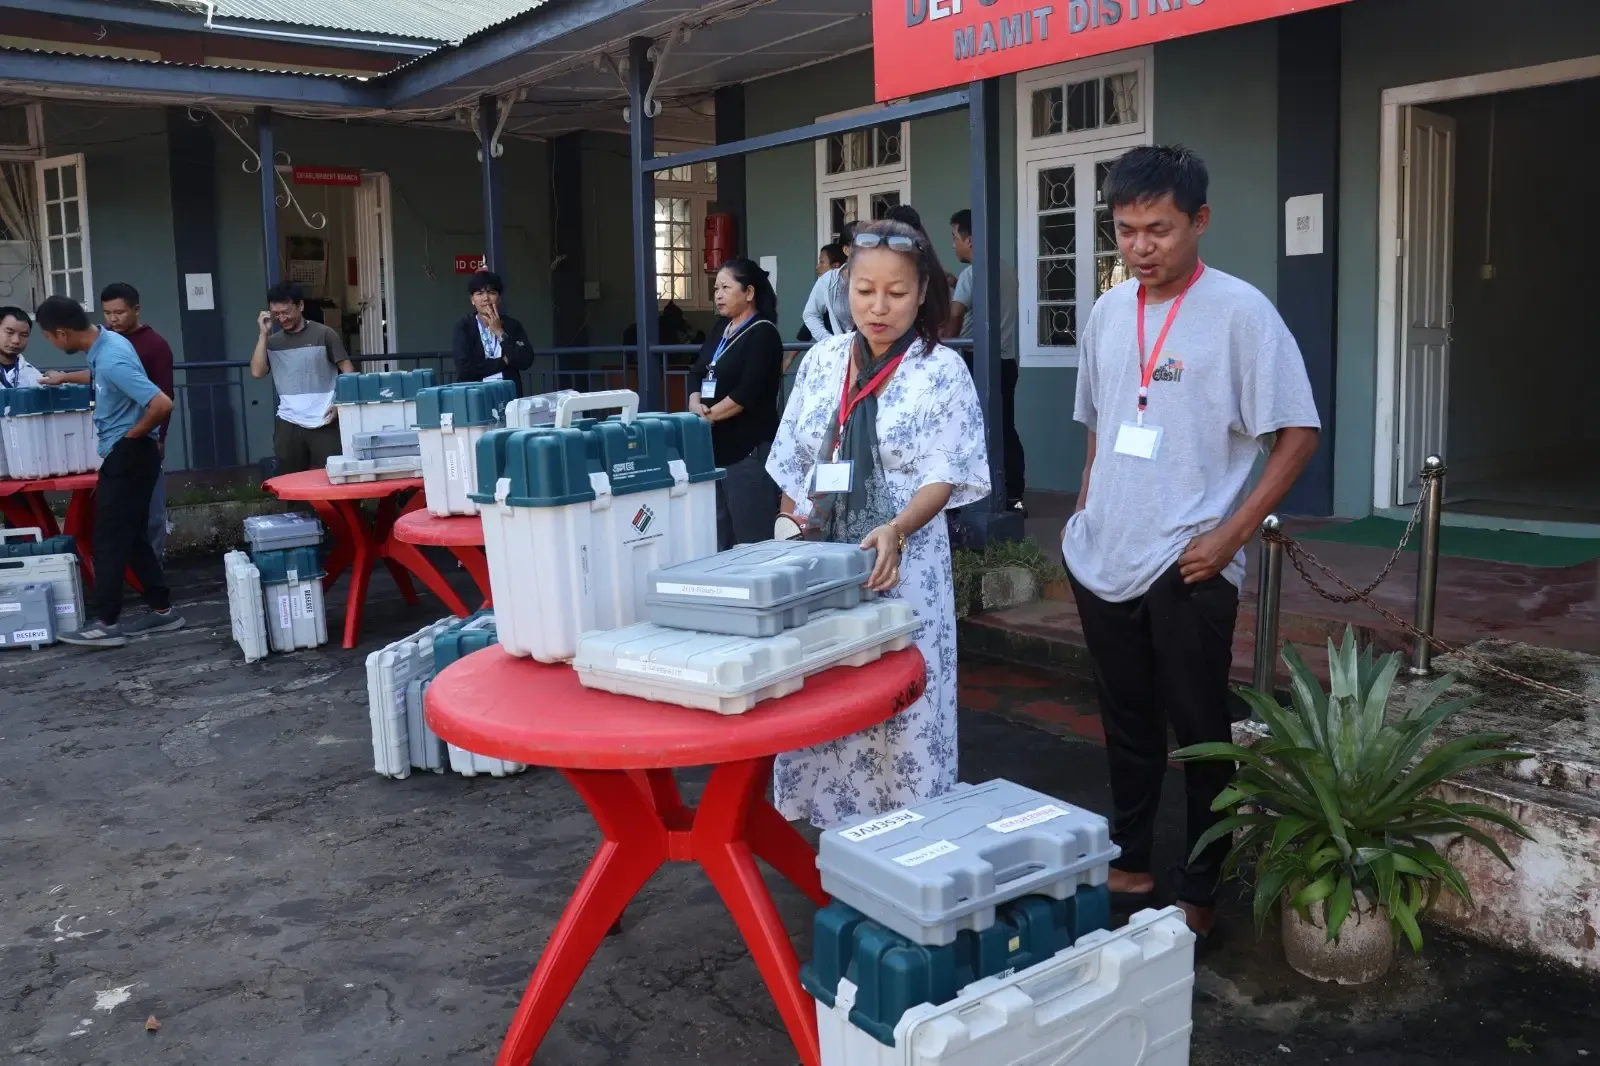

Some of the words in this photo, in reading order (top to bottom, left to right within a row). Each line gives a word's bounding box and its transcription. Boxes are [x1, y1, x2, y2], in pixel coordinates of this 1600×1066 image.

[954, 6, 1054, 61] MAMIT
[455, 260, 467, 269] ID
[304, 590, 312, 613] RESERVE
[16, 631, 45, 639] RESERVE
[848, 813, 913, 838] RESERVE
